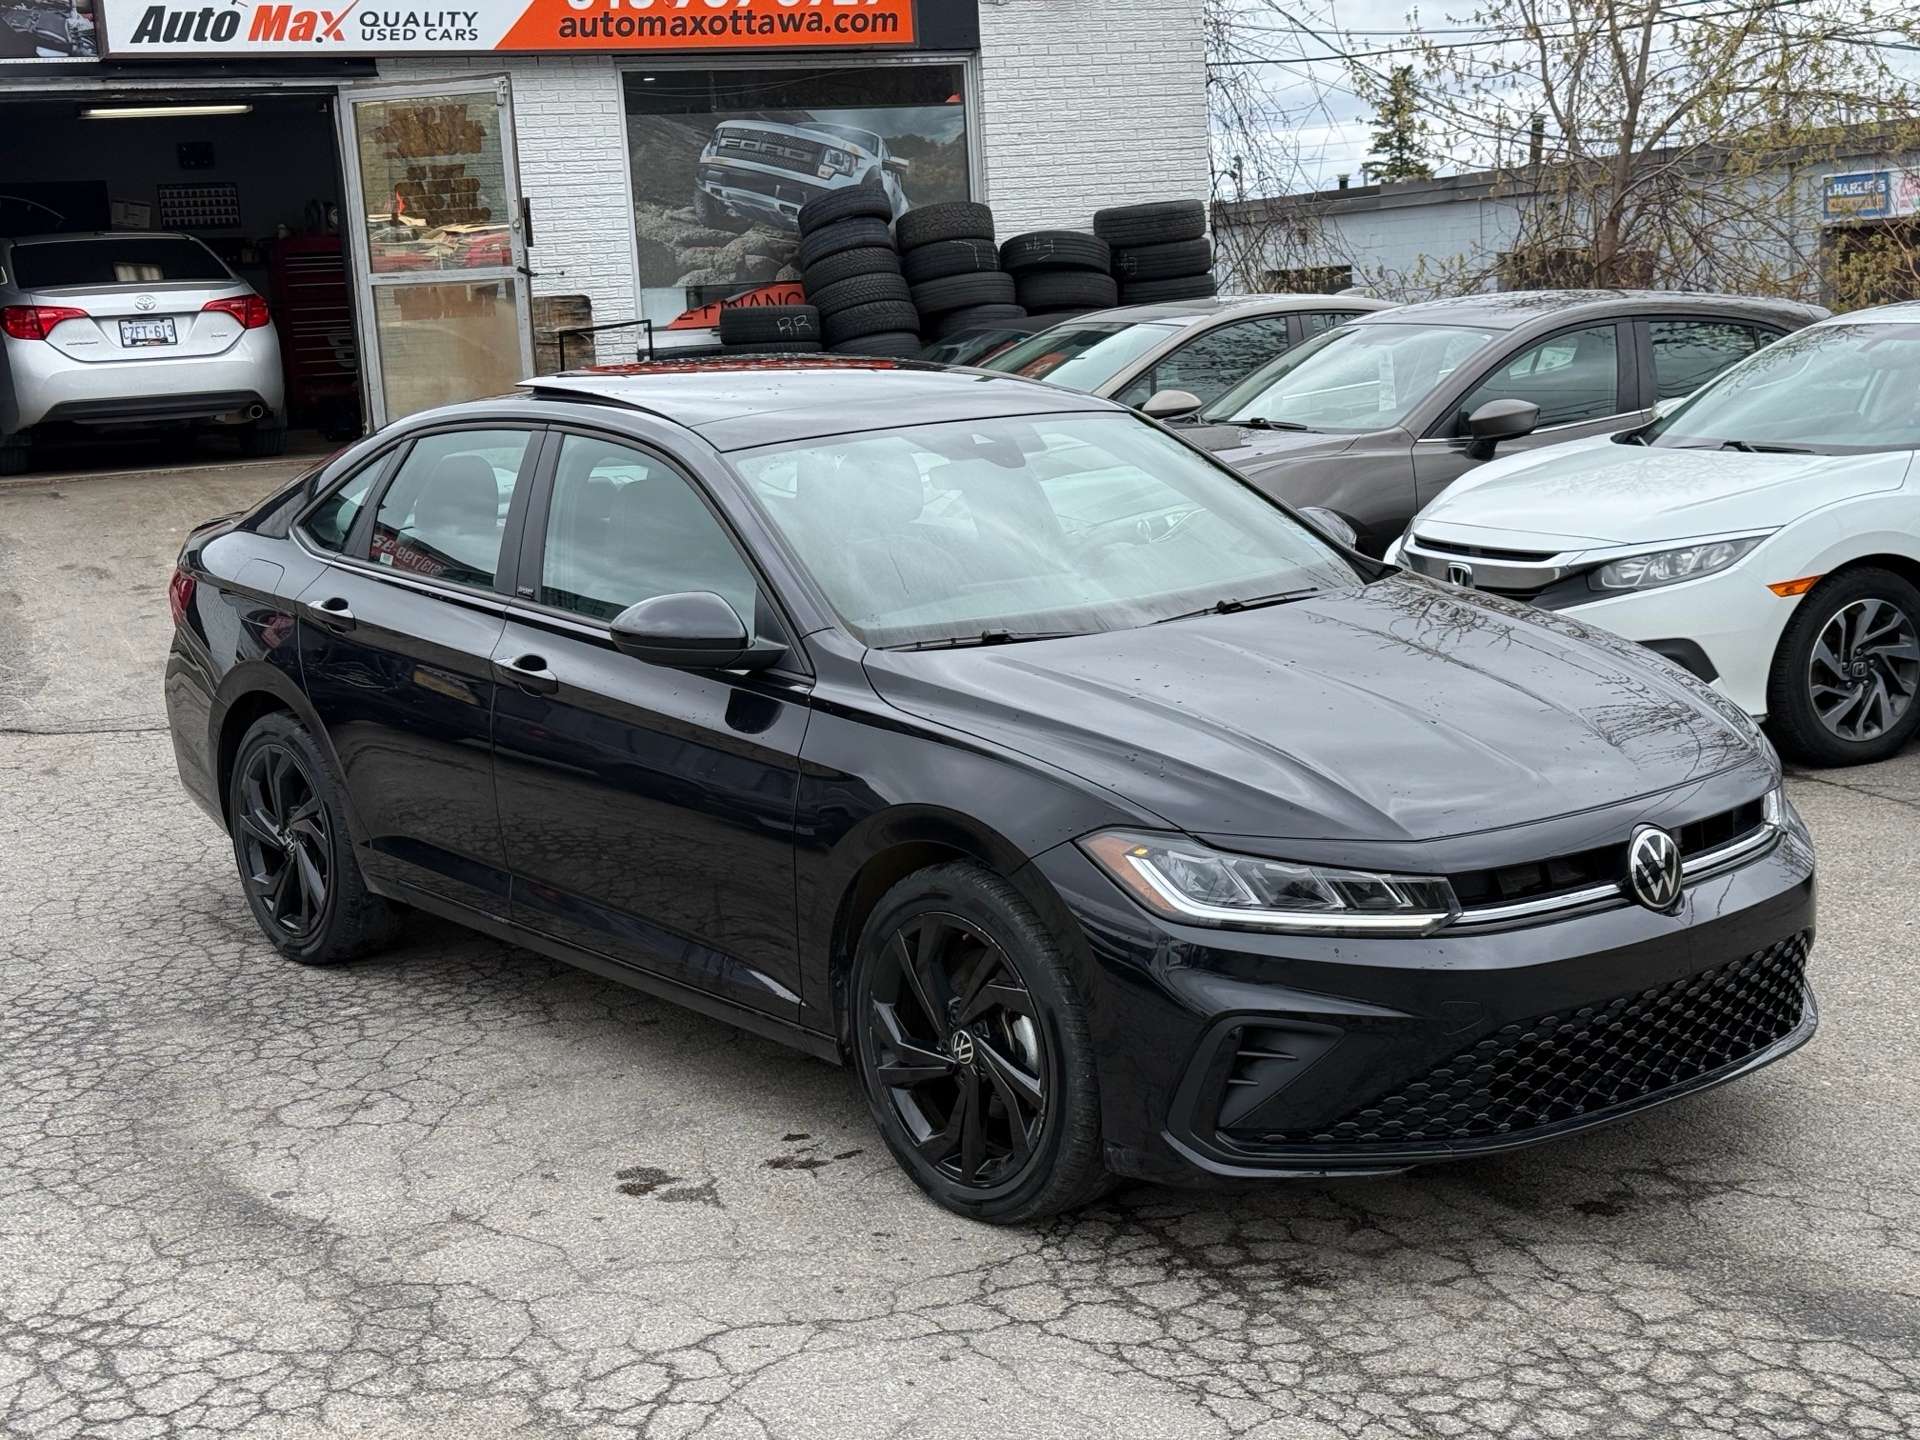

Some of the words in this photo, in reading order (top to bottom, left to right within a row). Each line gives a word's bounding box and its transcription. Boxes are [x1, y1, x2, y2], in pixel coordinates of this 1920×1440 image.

[129, 5, 241, 43] Auto
[248, 3, 350, 42] Max
[359, 11, 479, 27] QUALITY
[559, 9, 898, 38] automaxottawa.com
[361, 28, 417, 41] USED
[425, 28, 479, 41] CARS
[720, 138, 813, 162] FORD
